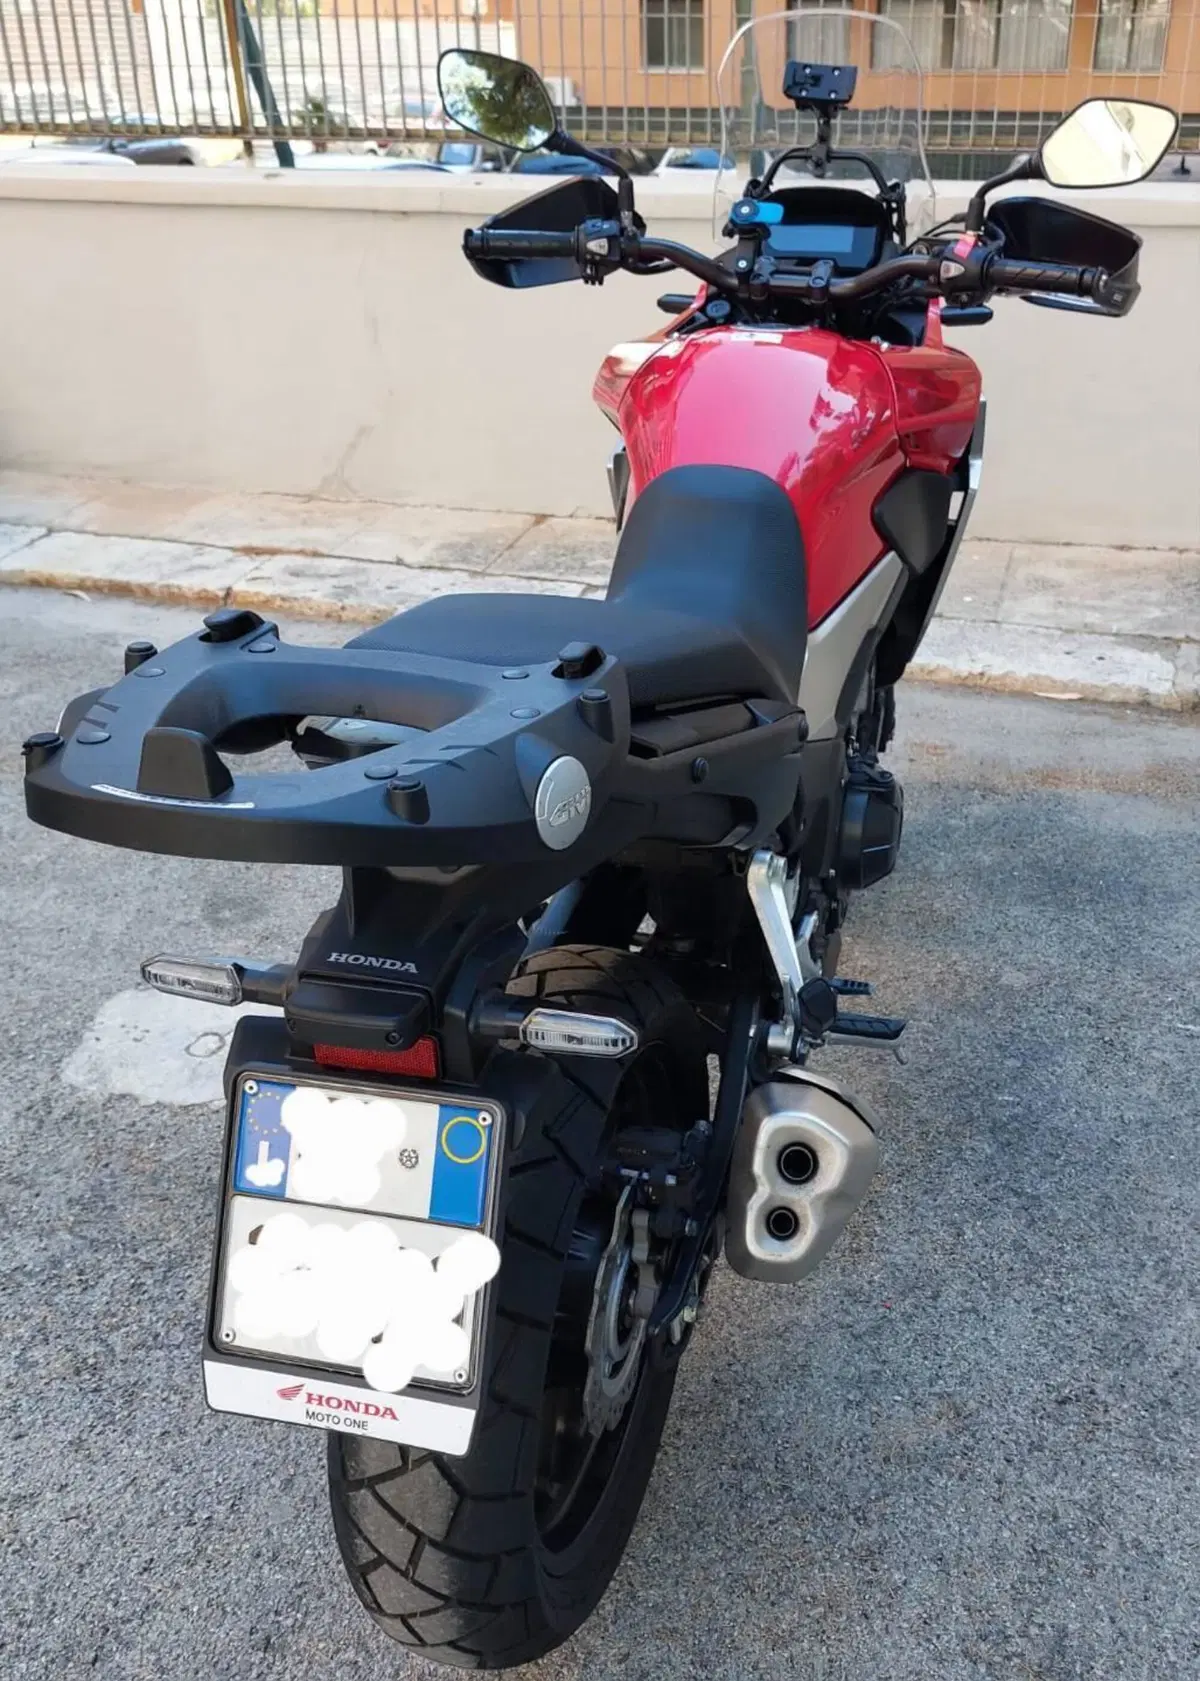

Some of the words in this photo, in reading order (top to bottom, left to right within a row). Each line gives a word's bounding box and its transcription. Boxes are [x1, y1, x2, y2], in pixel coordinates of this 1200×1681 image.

[326, 951, 419, 974] HONDA
[305, 1391, 400, 1421] HONDA
[305, 1408, 341, 1425] MOTO
[343, 1417, 369, 1431] ONE
